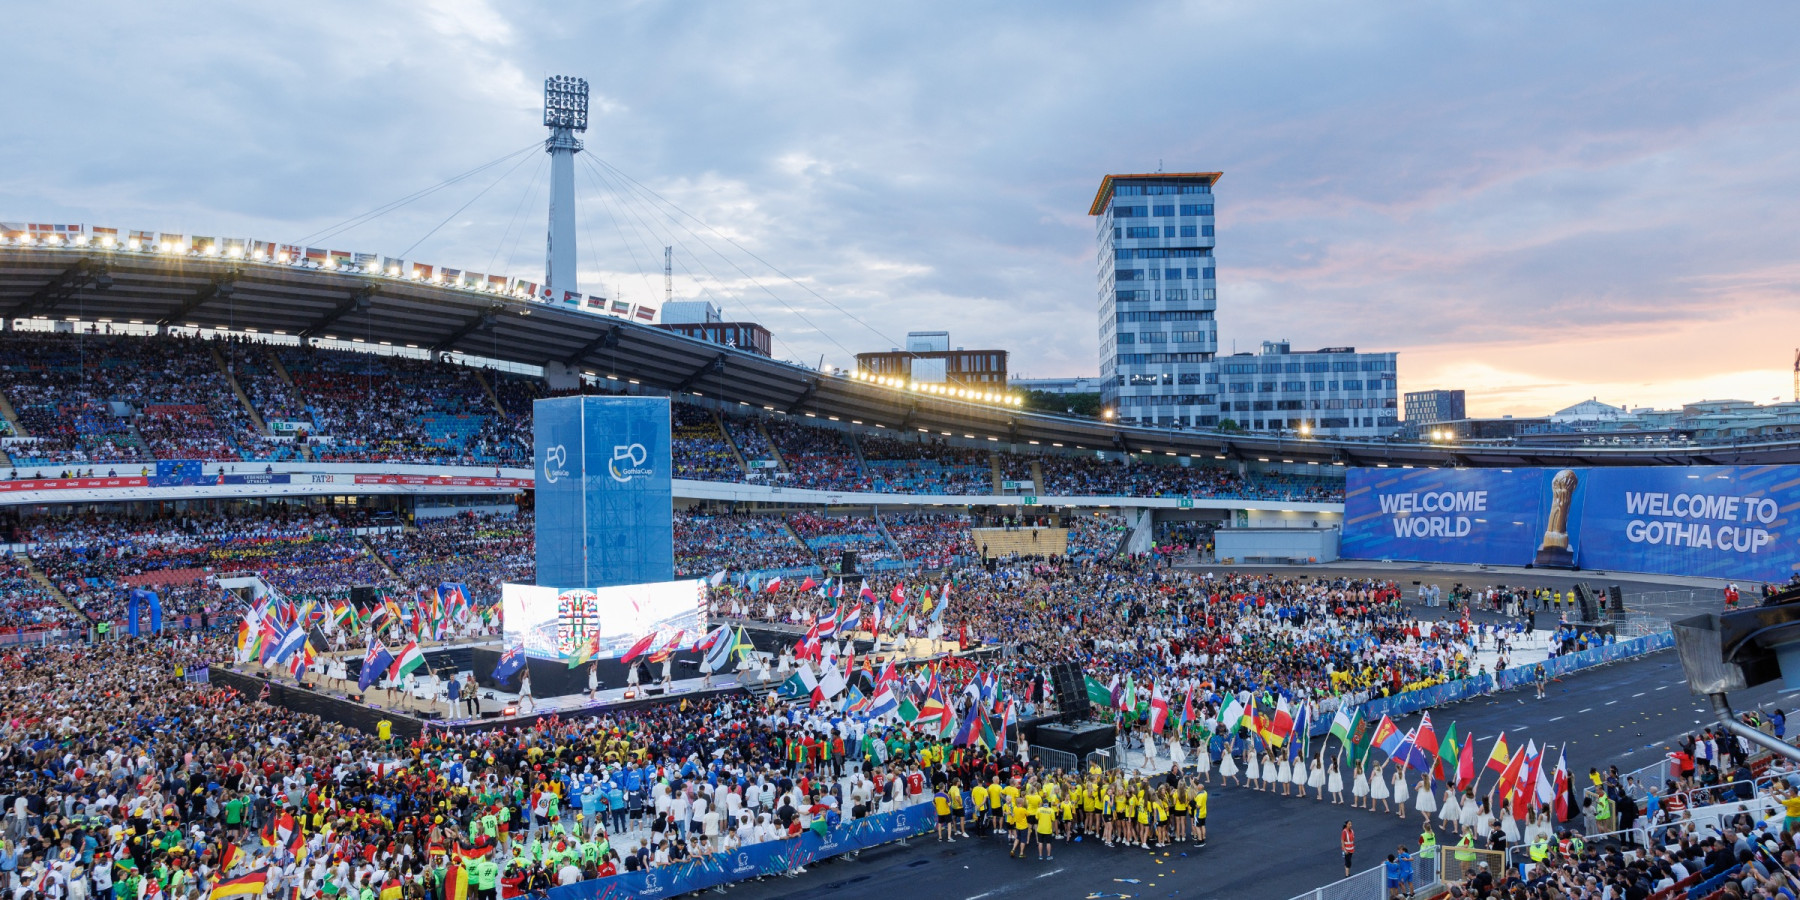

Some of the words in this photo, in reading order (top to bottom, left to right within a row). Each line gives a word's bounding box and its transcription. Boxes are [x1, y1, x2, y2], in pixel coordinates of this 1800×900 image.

[614, 443, 647, 468] 50
[312, 475, 334, 483] FAT21
[1379, 490, 1488, 514] WELCOME
[1625, 491, 1740, 521] WELCOME
[1744, 497, 1778, 524] TO
[1393, 516, 1472, 538] WORLD
[1626, 519, 1713, 549] GOTHIA
[1716, 525, 1769, 554] CUP
[486, 820, 495, 829] 18
[585, 847, 594, 857] 12
